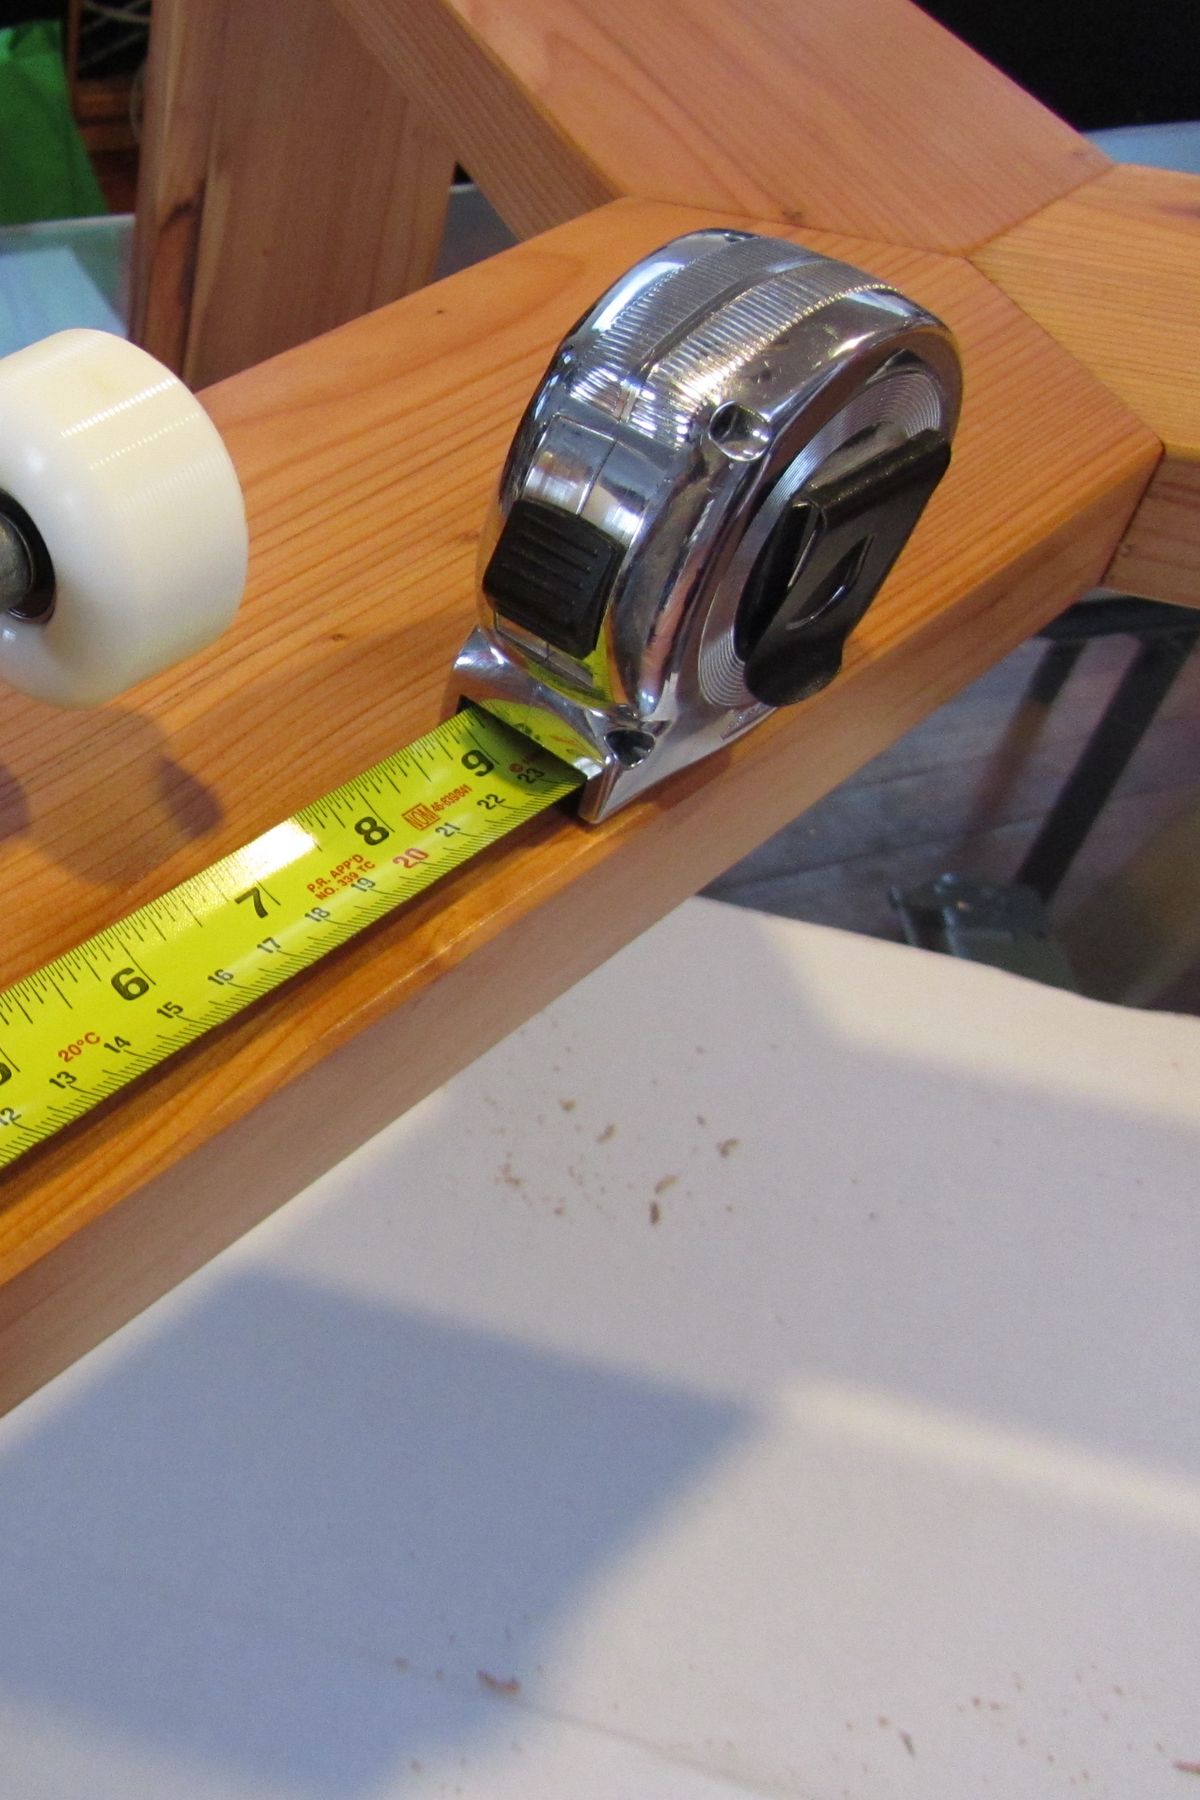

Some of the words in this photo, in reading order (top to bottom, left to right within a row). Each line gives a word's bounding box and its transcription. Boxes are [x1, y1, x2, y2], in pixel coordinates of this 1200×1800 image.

[461, 750, 495, 776] 9
[517, 768, 544, 784] 23
[477, 793, 506, 810] 22
[354, 816, 390, 846] 8
[435, 822, 461, 837] 21
[392, 848, 429, 869] 20
[351, 877, 376, 892] 19
[234, 887, 269, 919] 7
[304, 907, 330, 922] 18
[256, 936, 282, 954] 17
[111, 968, 149, 1001] 6
[207, 968, 234, 986] 16
[156, 1001, 184, 1019] 15
[104, 1035, 132, 1054] 14
[49, 1071, 78, 1090] 13
